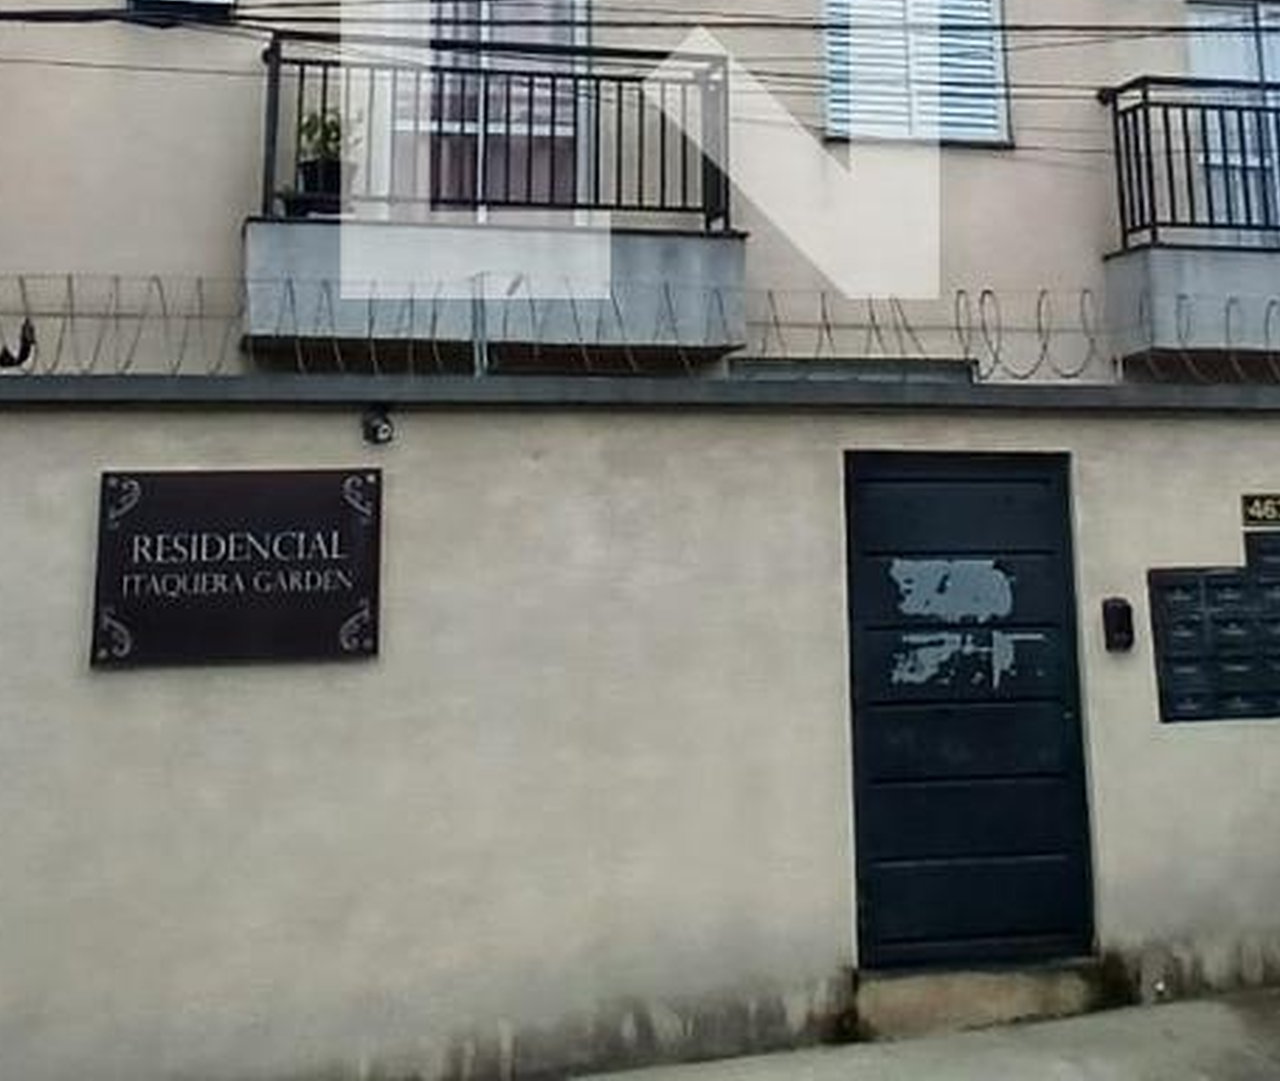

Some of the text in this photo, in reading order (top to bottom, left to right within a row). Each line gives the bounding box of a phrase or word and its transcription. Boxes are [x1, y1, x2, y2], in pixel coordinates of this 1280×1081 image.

[132, 531, 349, 563] RESIDENCIAL
[121, 570, 353, 598] ITAQUERA GARDEN
